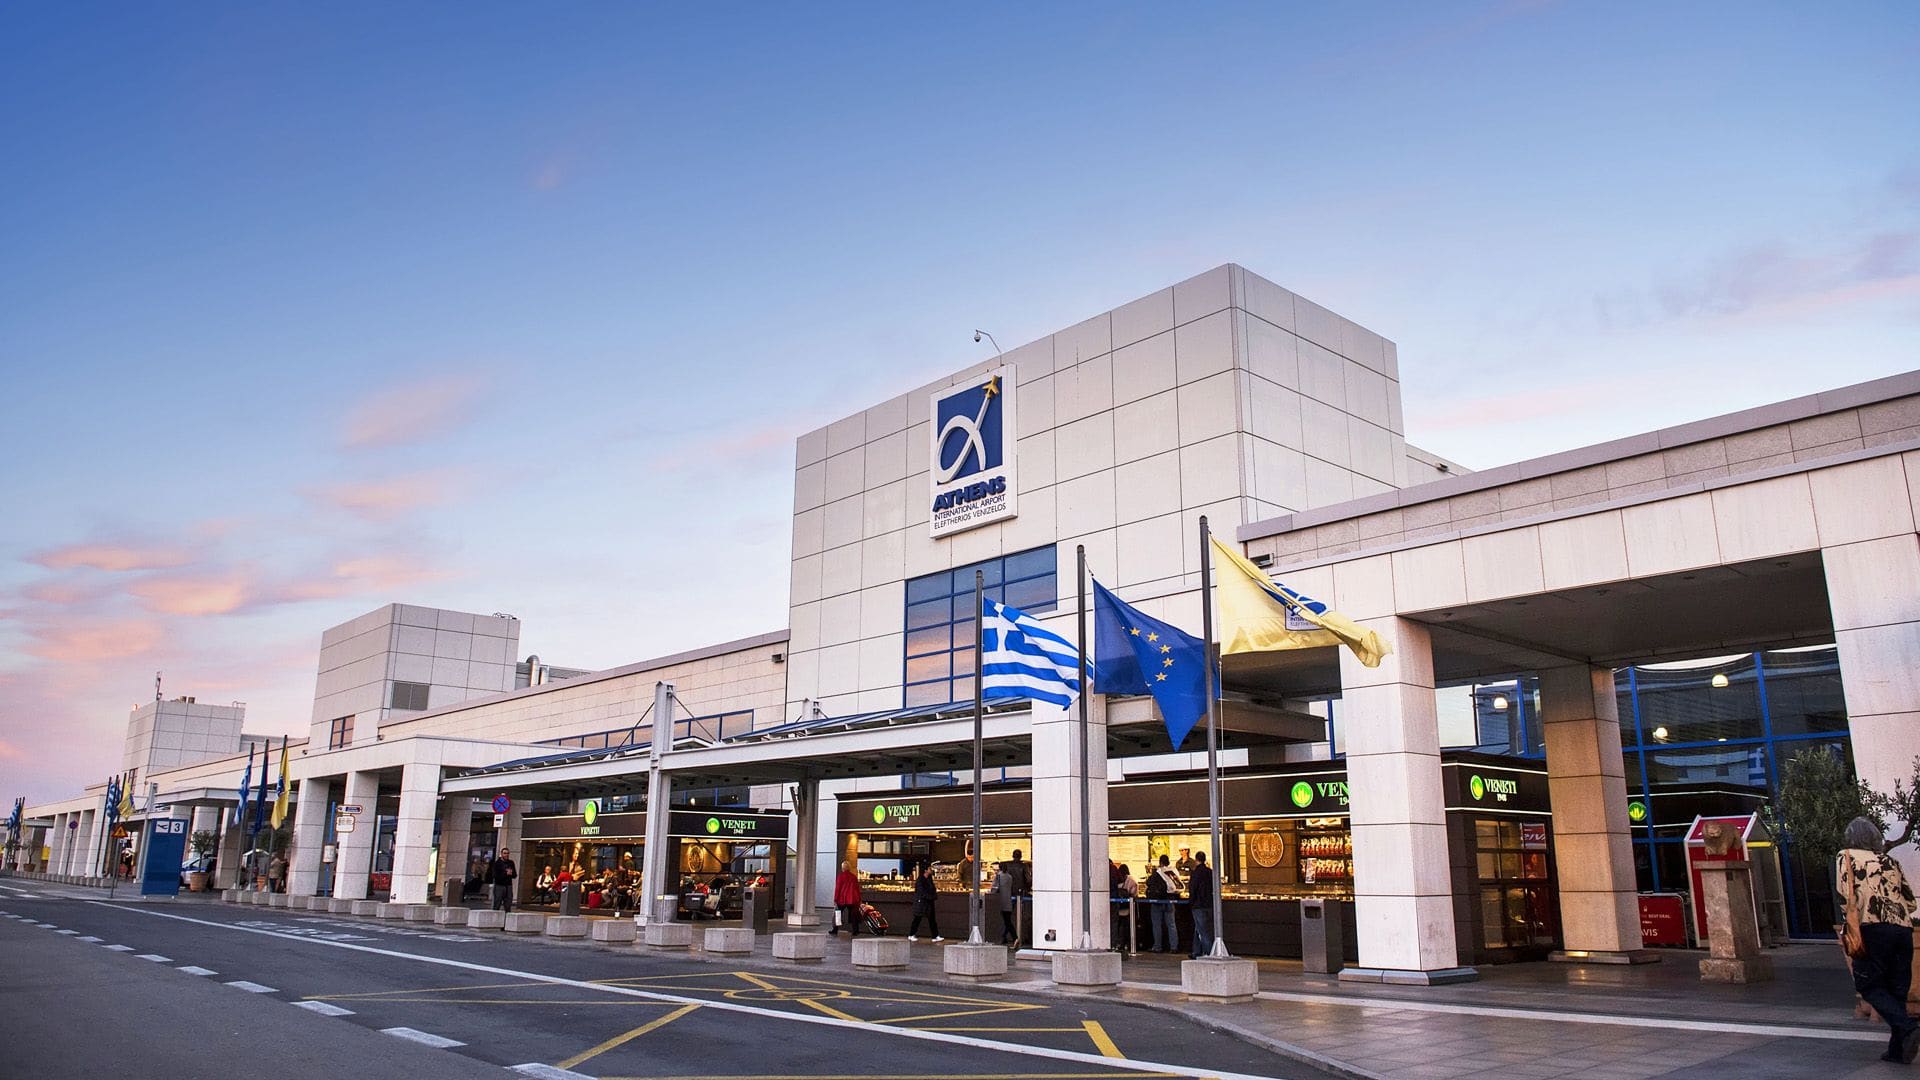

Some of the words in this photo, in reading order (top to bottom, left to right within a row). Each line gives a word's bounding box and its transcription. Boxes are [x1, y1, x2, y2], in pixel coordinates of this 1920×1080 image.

[932, 475, 1006, 512] ATHENS
[934, 502, 978, 521] INTERNATIONAL
[980, 493, 1006, 508] AIRPORT
[934, 513, 971, 529] ELEFTHERIOS
[973, 503, 1006, 517] VENIZELOS
[1484, 778, 1517, 794] VENETI
[887, 804, 920, 816] VENETI
[174, 823, 180, 832] 3
[721, 819, 756, 829] VENETI
